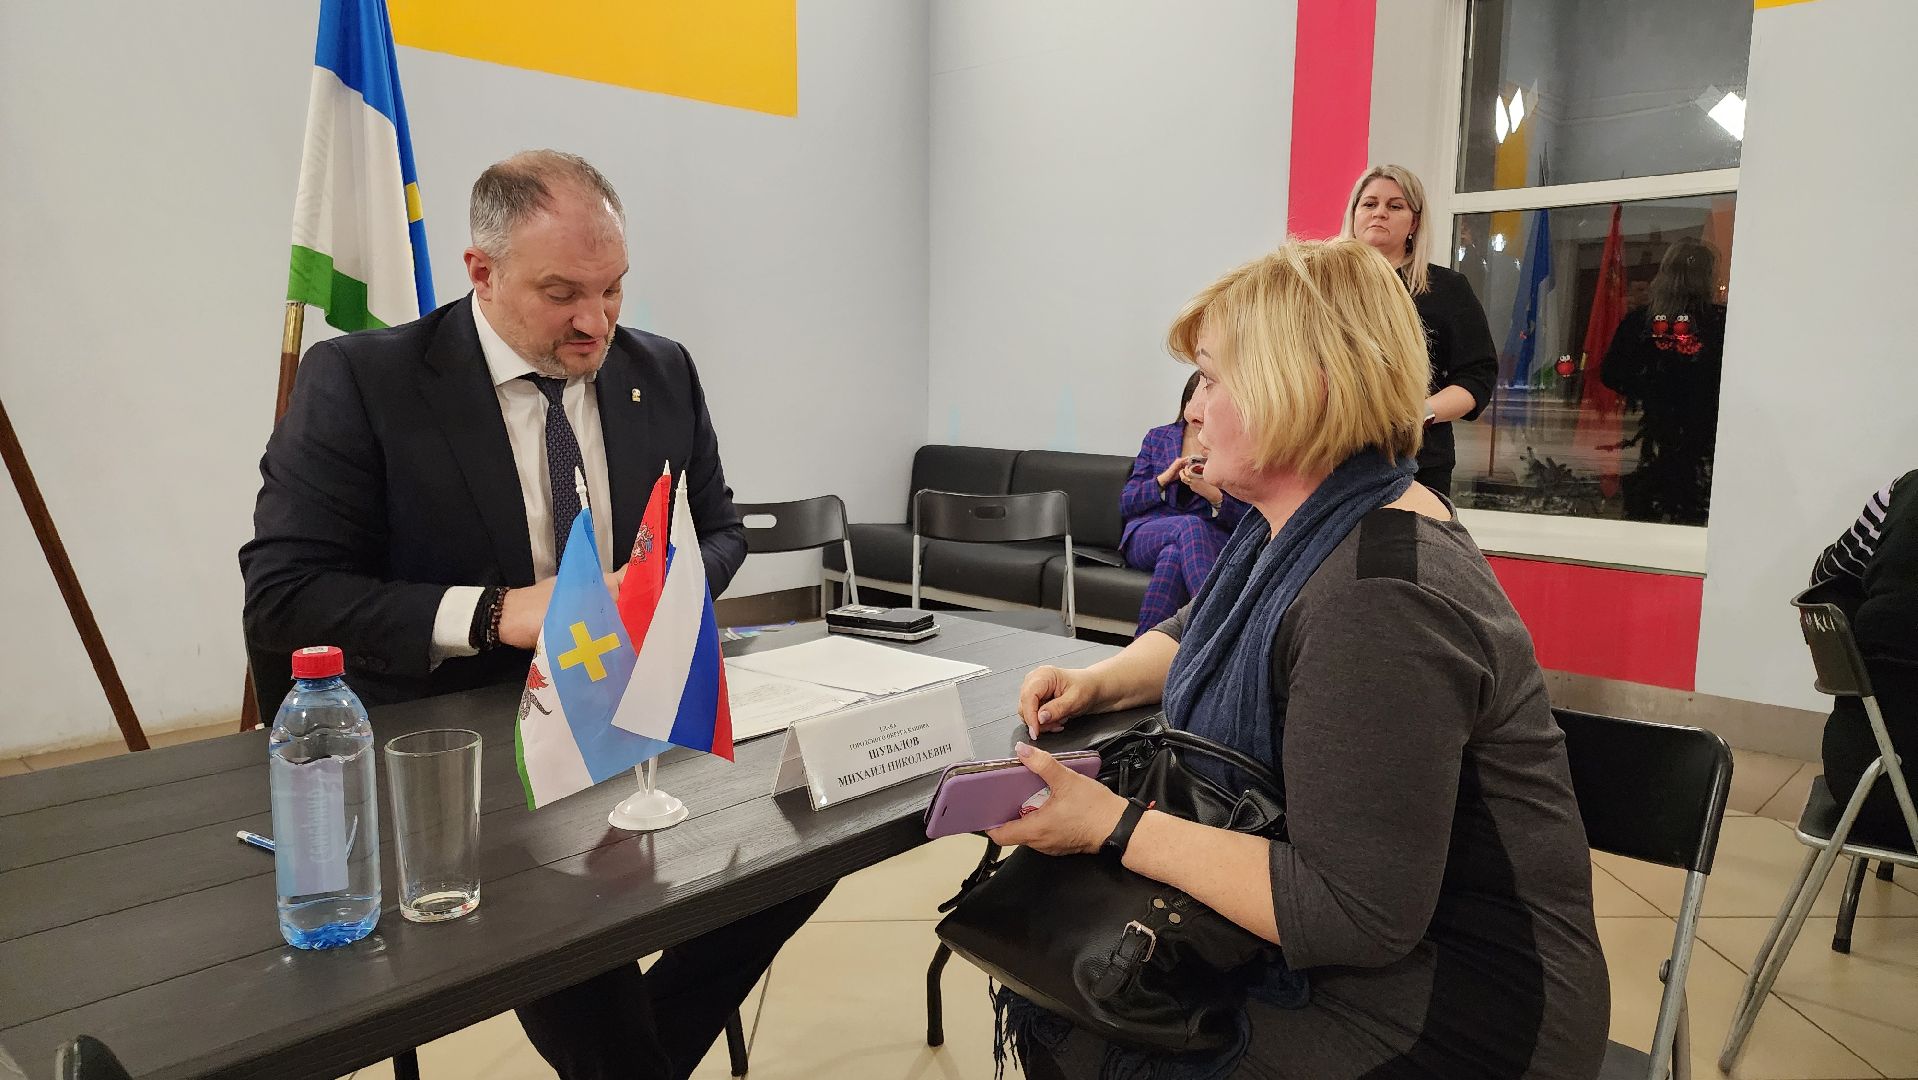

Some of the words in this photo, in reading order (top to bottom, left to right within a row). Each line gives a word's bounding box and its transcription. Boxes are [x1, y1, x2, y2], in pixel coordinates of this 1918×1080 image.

[868, 736, 920, 760] ШУВАЛОВ
[837, 763, 886, 788] МИХАИЛ
[887, 743, 952, 772] НИКОЛАЕВИЧ
